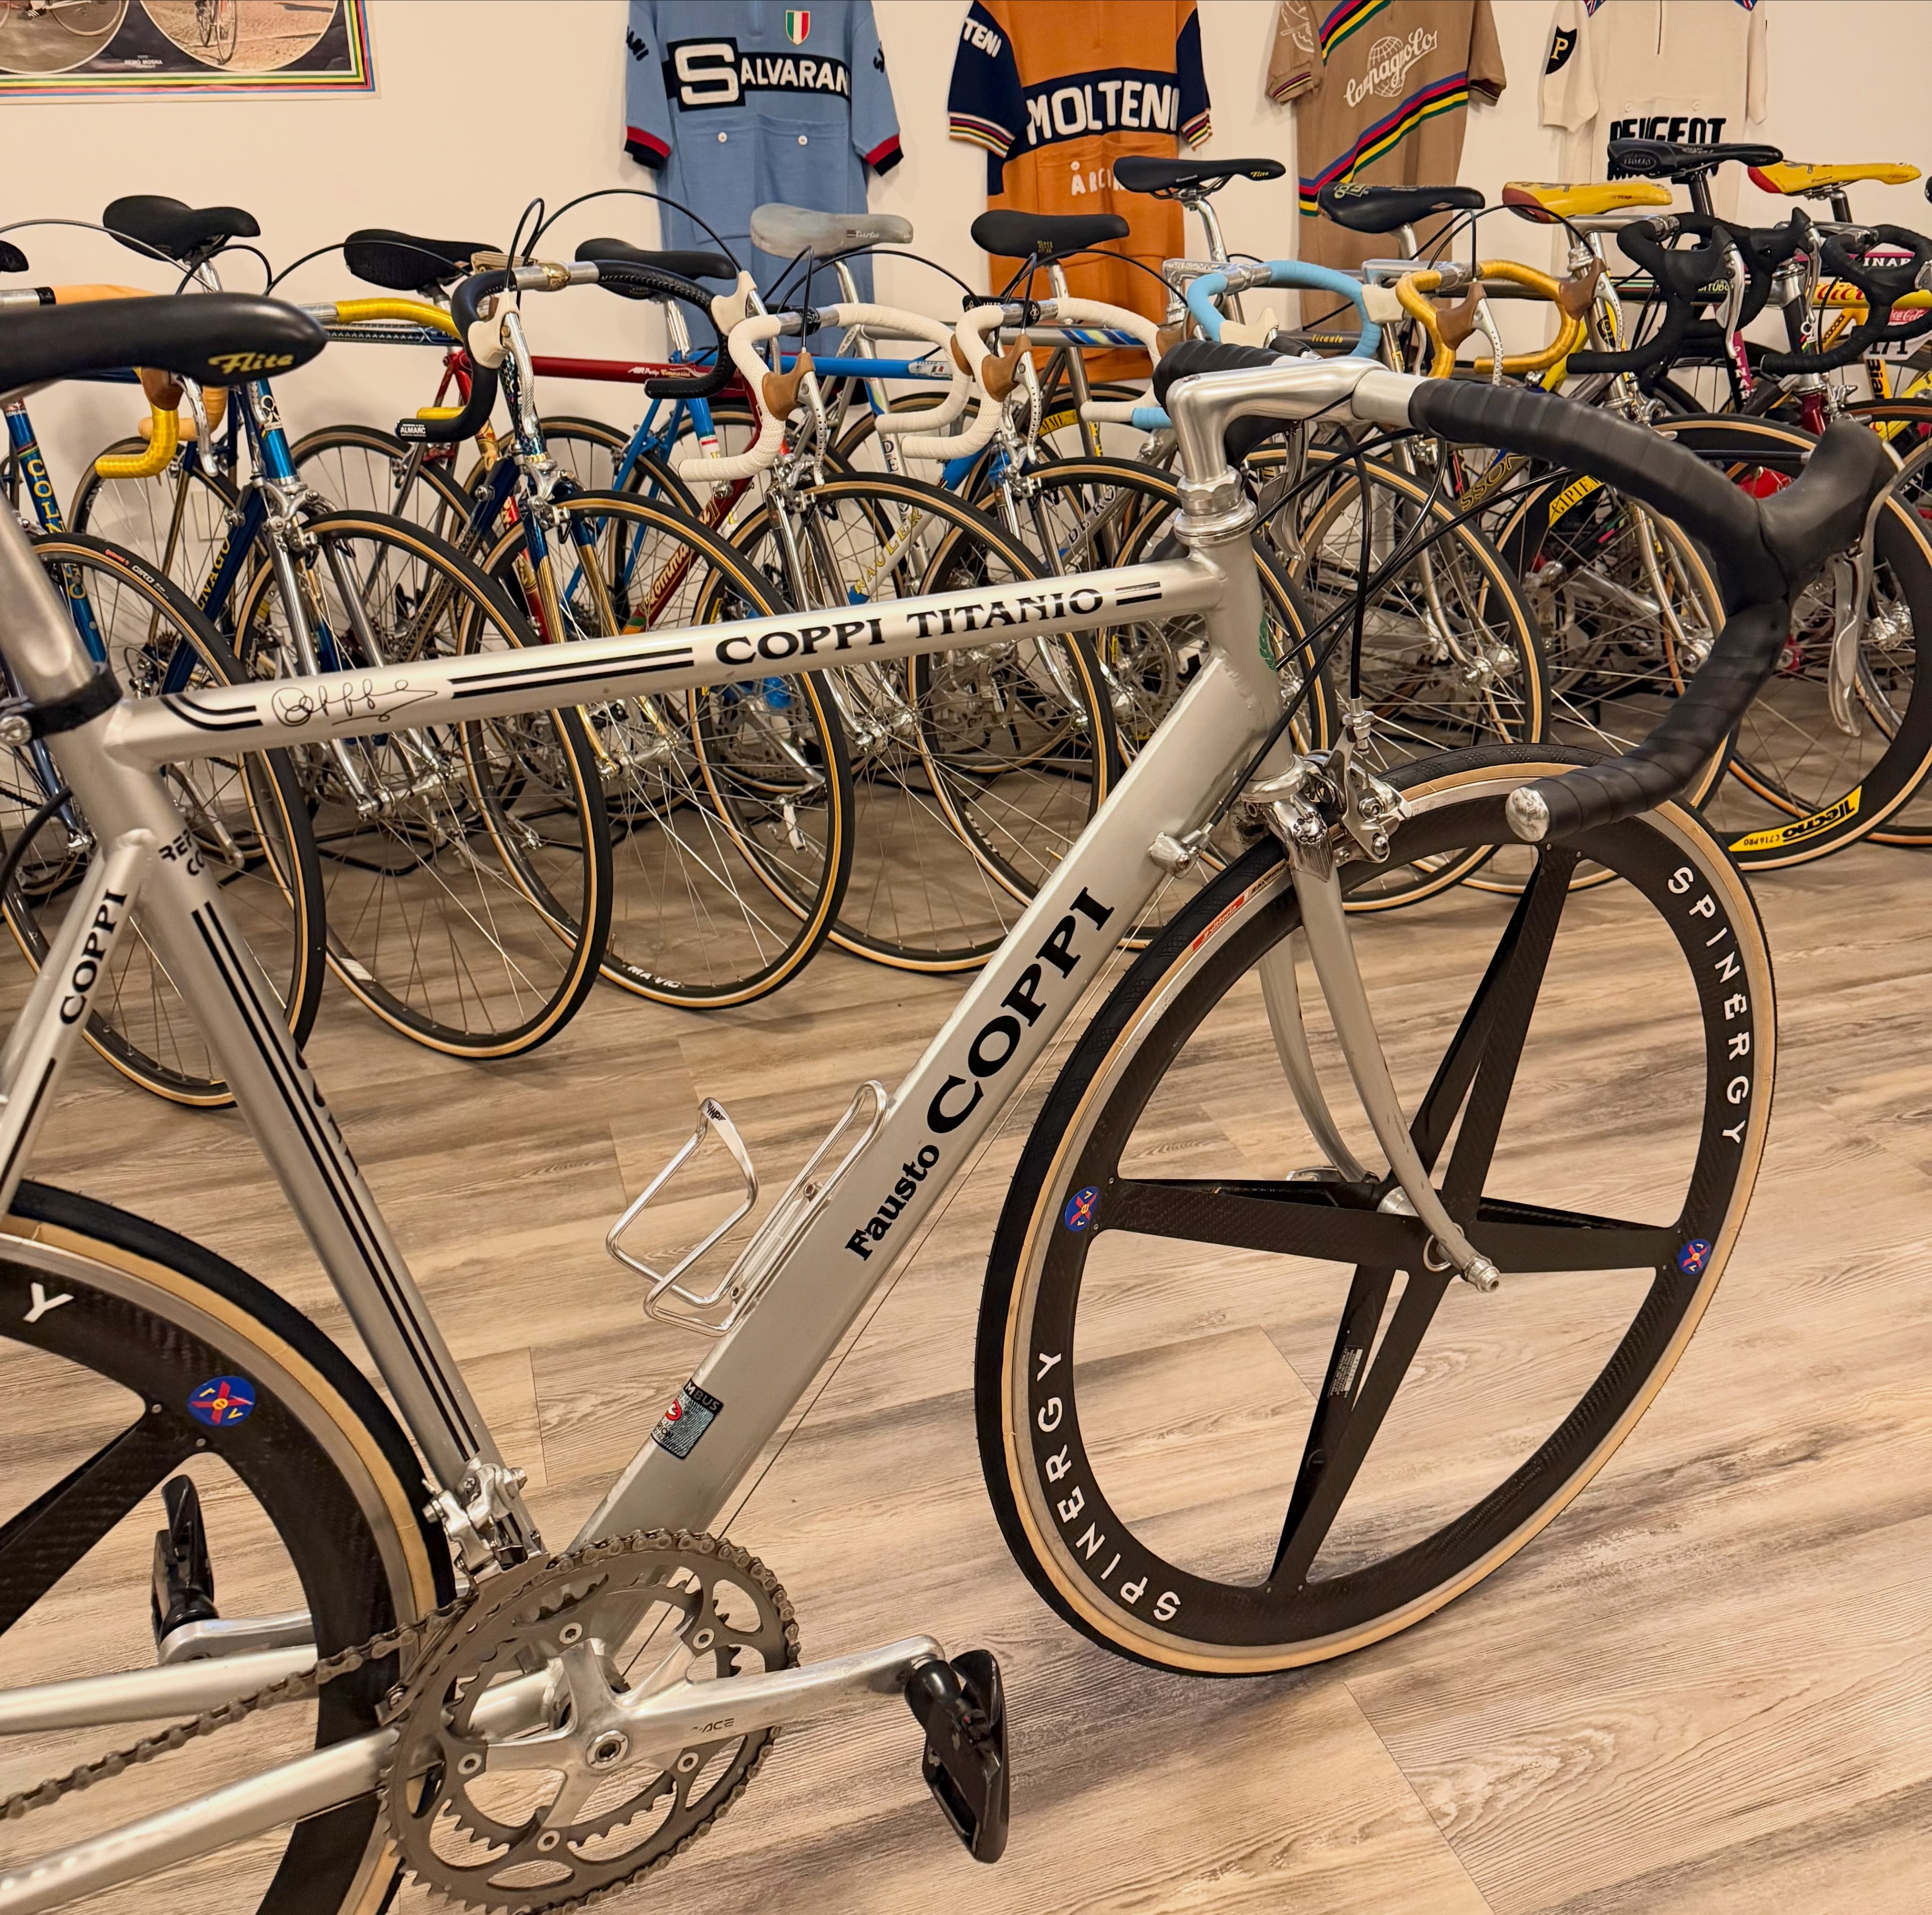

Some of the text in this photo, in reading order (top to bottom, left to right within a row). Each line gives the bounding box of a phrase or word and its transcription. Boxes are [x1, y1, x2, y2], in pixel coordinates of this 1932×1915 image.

[1550, 37, 1569, 60] P
[1026, 80, 1179, 145] MOLTENI
[856, 230, 880, 238] Turbo
[208, 351, 295, 375] Flite
[716, 588, 1104, 666] COPPI TITANIO
[59, 888, 128, 1025] COPPI
[627, 965, 682, 988] MAVIC
[1667, 866, 1751, 1144] SPINERGY
[844, 886, 1115, 1261] Fausto COPPI
[1037, 1351, 1181, 1622] SPINERGY
